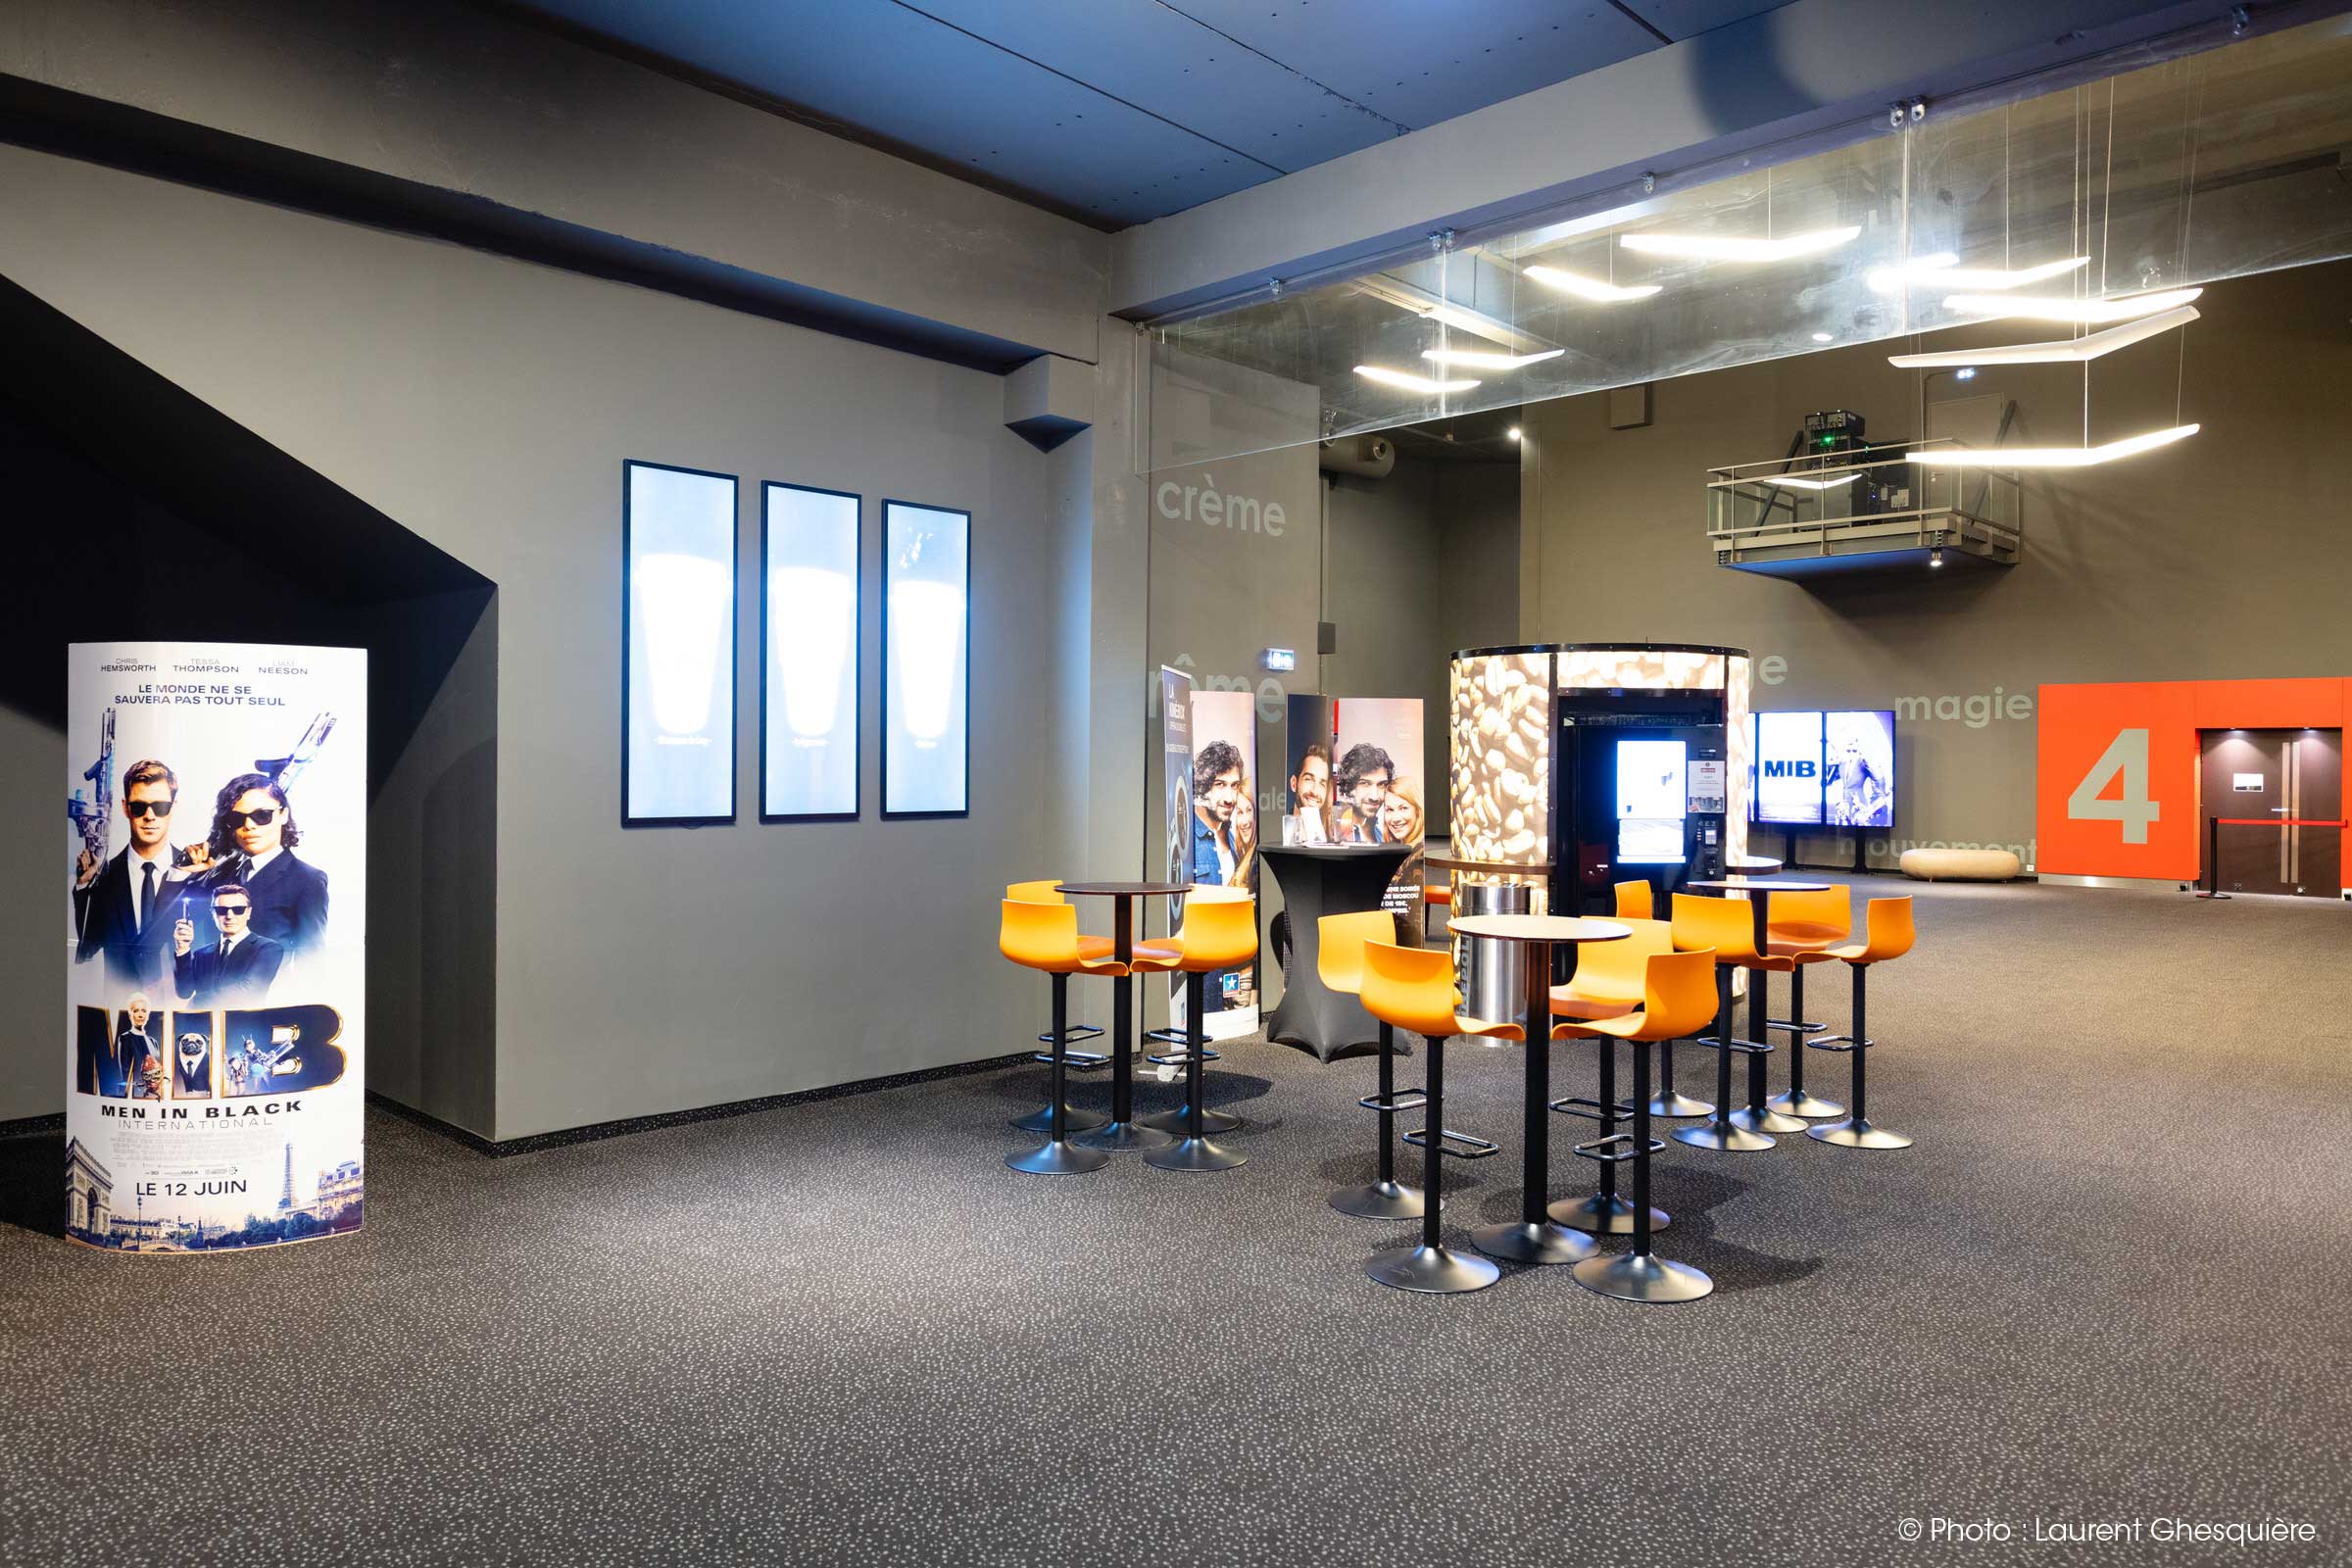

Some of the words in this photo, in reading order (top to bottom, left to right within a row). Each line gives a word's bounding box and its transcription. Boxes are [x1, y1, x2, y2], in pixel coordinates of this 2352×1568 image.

[1156, 472, 1287, 537] crème
[258, 666, 308, 675] NEESON
[138, 684, 152, 693] LE
[156, 684, 206, 694] MONDE
[210, 685, 229, 694] NE
[234, 685, 252, 695] SE
[115, 695, 171, 705] SAUVERA
[174, 695, 201, 705] PAS
[205, 696, 243, 706] TOUT
[248, 696, 285, 707] SEUL
[1894, 685, 2034, 729] magie
[1764, 760, 1817, 778] MIB
[2067, 728, 2160, 845] 4
[76, 1004, 347, 1102] MIB
[101, 1104, 145, 1119] MEN
[161, 1107, 187, 1119] IN
[205, 1100, 302, 1119] BLACK
[118, 1117, 273, 1130] INTERNATIONAL
[136, 1182, 157, 1197] LE
[165, 1182, 186, 1197] 12
[194, 1180, 247, 1197] JUIN
